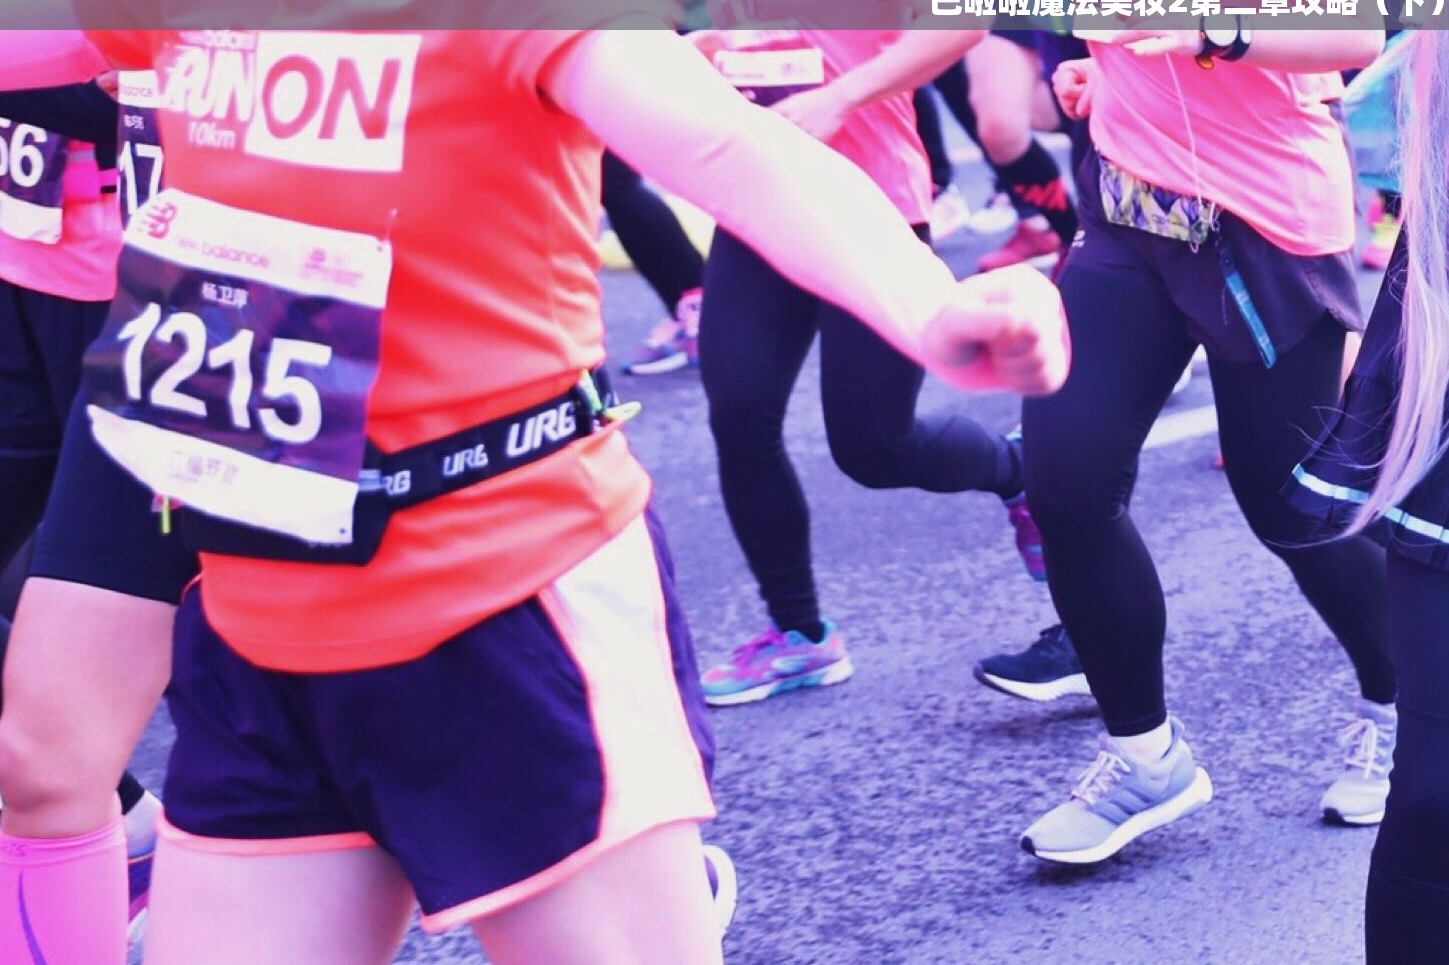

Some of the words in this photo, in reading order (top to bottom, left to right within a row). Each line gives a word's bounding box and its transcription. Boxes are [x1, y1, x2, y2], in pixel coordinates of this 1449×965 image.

[262, 54, 402, 139] ON
[188, 121, 236, 148] 10km
[202, 242, 270, 269] balance
[117, 302, 332, 444] 1215
